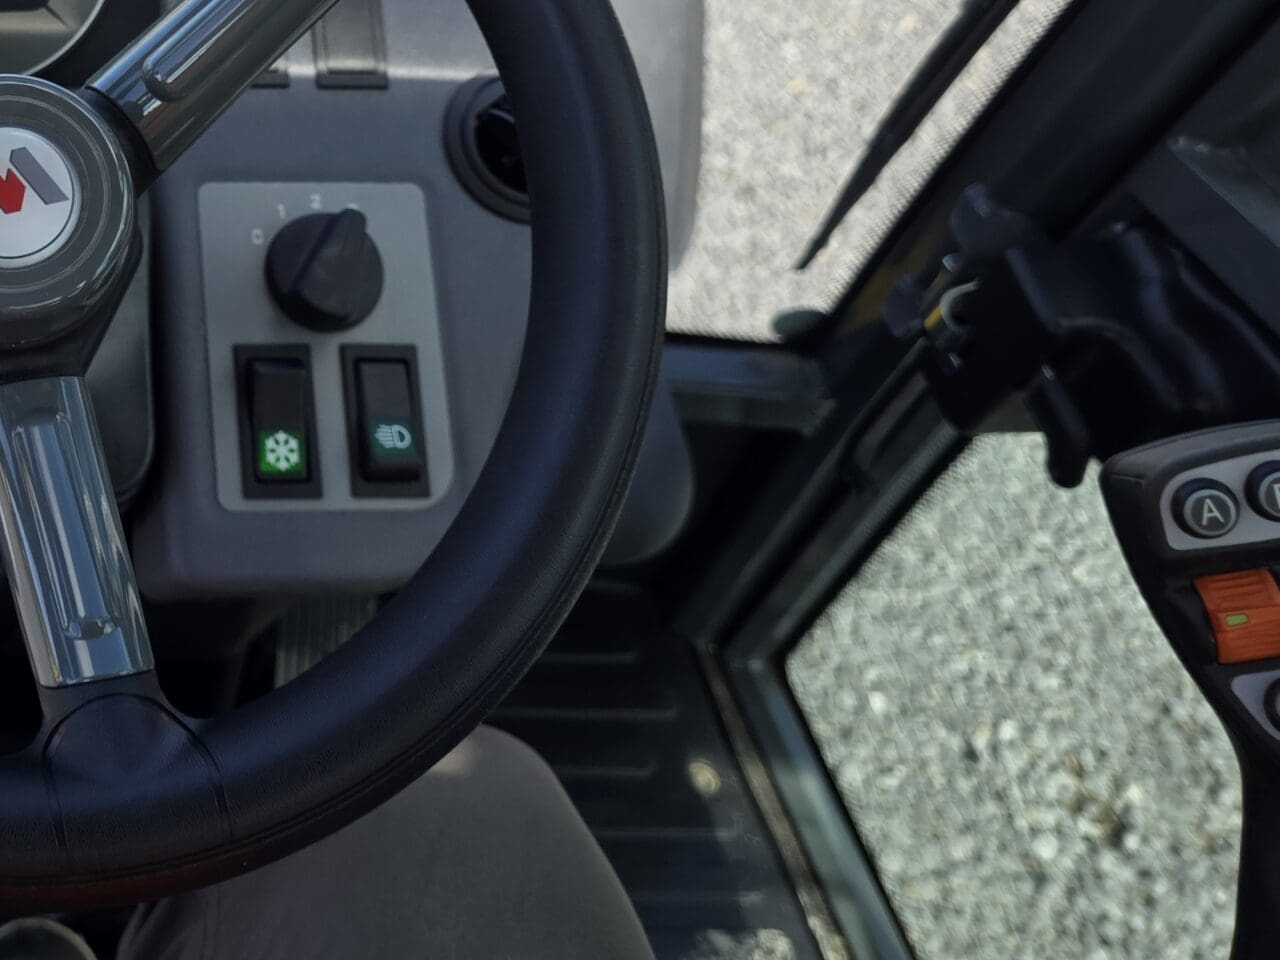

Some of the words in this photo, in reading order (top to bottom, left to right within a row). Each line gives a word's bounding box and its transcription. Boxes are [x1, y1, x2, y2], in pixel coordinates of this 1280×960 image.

[251, 228, 264, 246] 0
[276, 203, 286, 219] 1
[309, 192, 323, 210] 2
[1201, 498, 1225, 526] A
